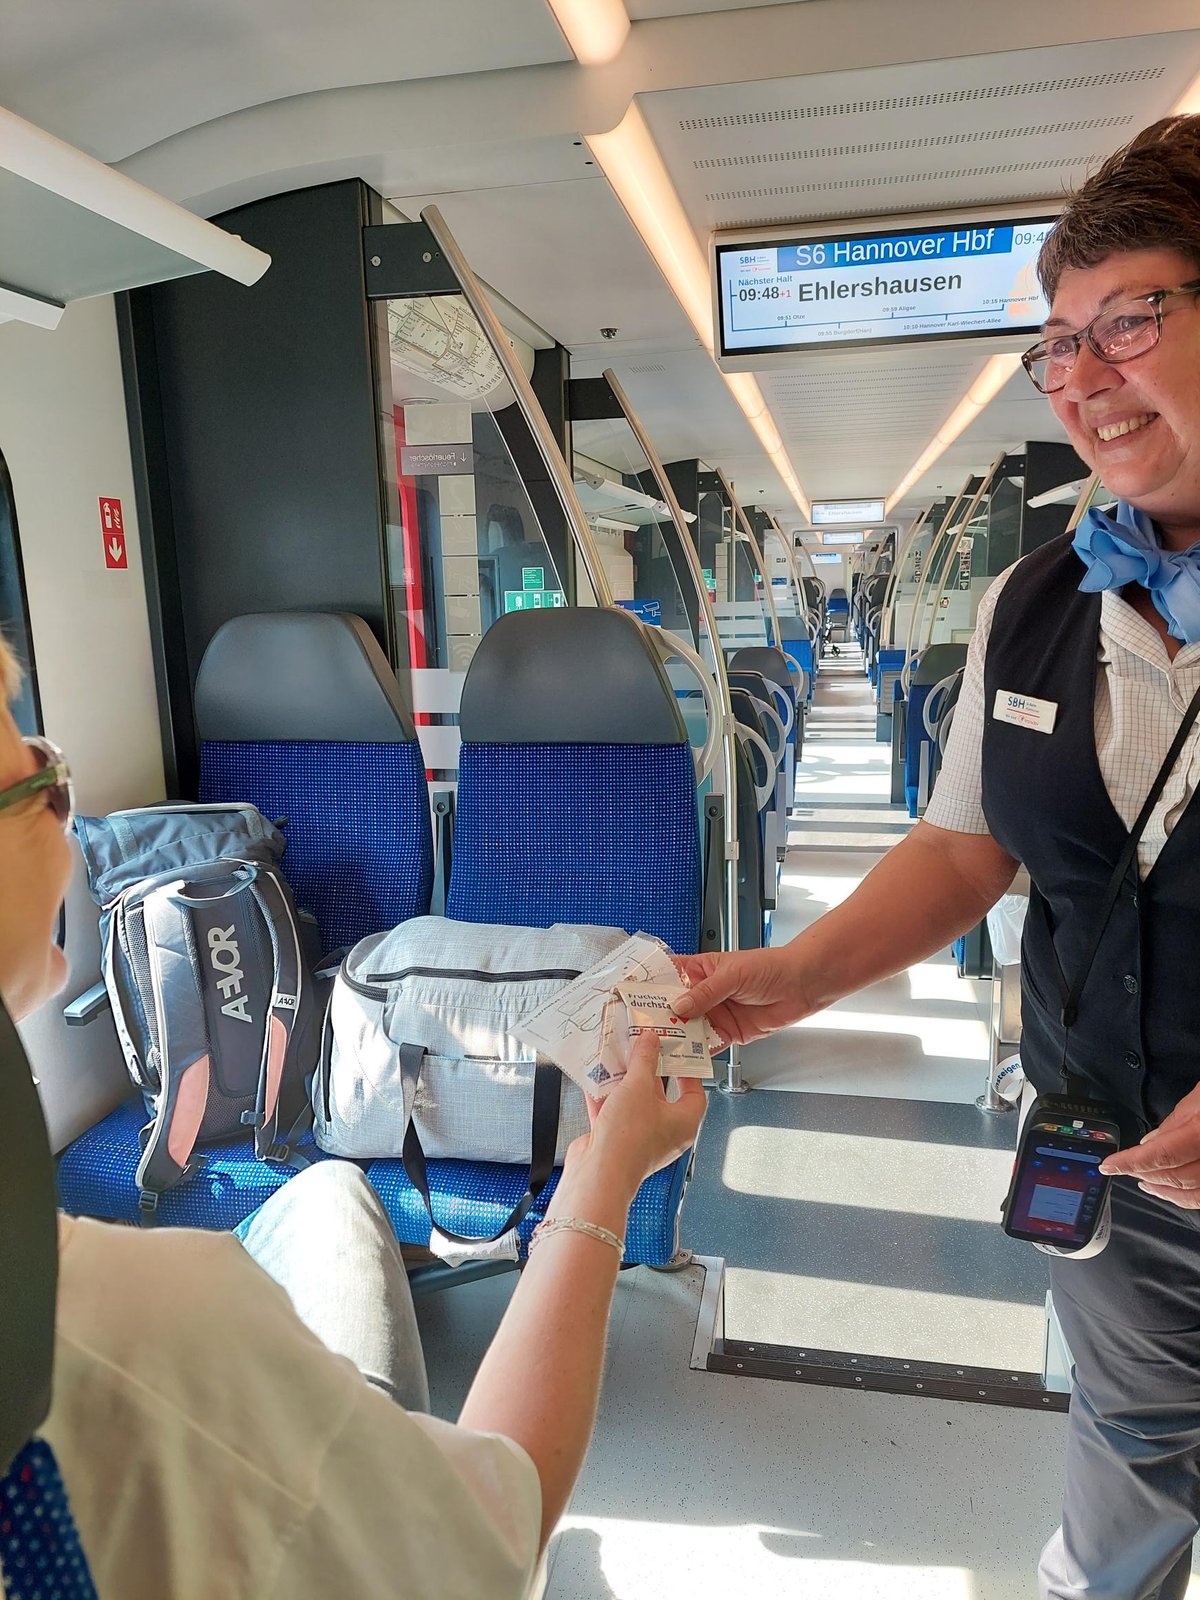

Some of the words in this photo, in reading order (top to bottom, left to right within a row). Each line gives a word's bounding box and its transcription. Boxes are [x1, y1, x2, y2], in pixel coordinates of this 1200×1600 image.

[1014, 231, 1045, 246] 09:4
[796, 243, 826, 266] S6
[834, 235, 946, 263] Hannover
[952, 228, 996, 252] Hbf
[739, 256, 756, 265] SBH
[738, 276, 774, 287] Nächster
[776, 275, 793, 284] Halt
[738, 286, 779, 301] 09:48
[798, 273, 963, 303] Ehlershausen
[919, 321, 946, 329] Hannover
[1007, 696, 1026, 710] SBH
[628, 993, 667, 1002] Fruchtig
[630, 999, 672, 1010] durchsta
